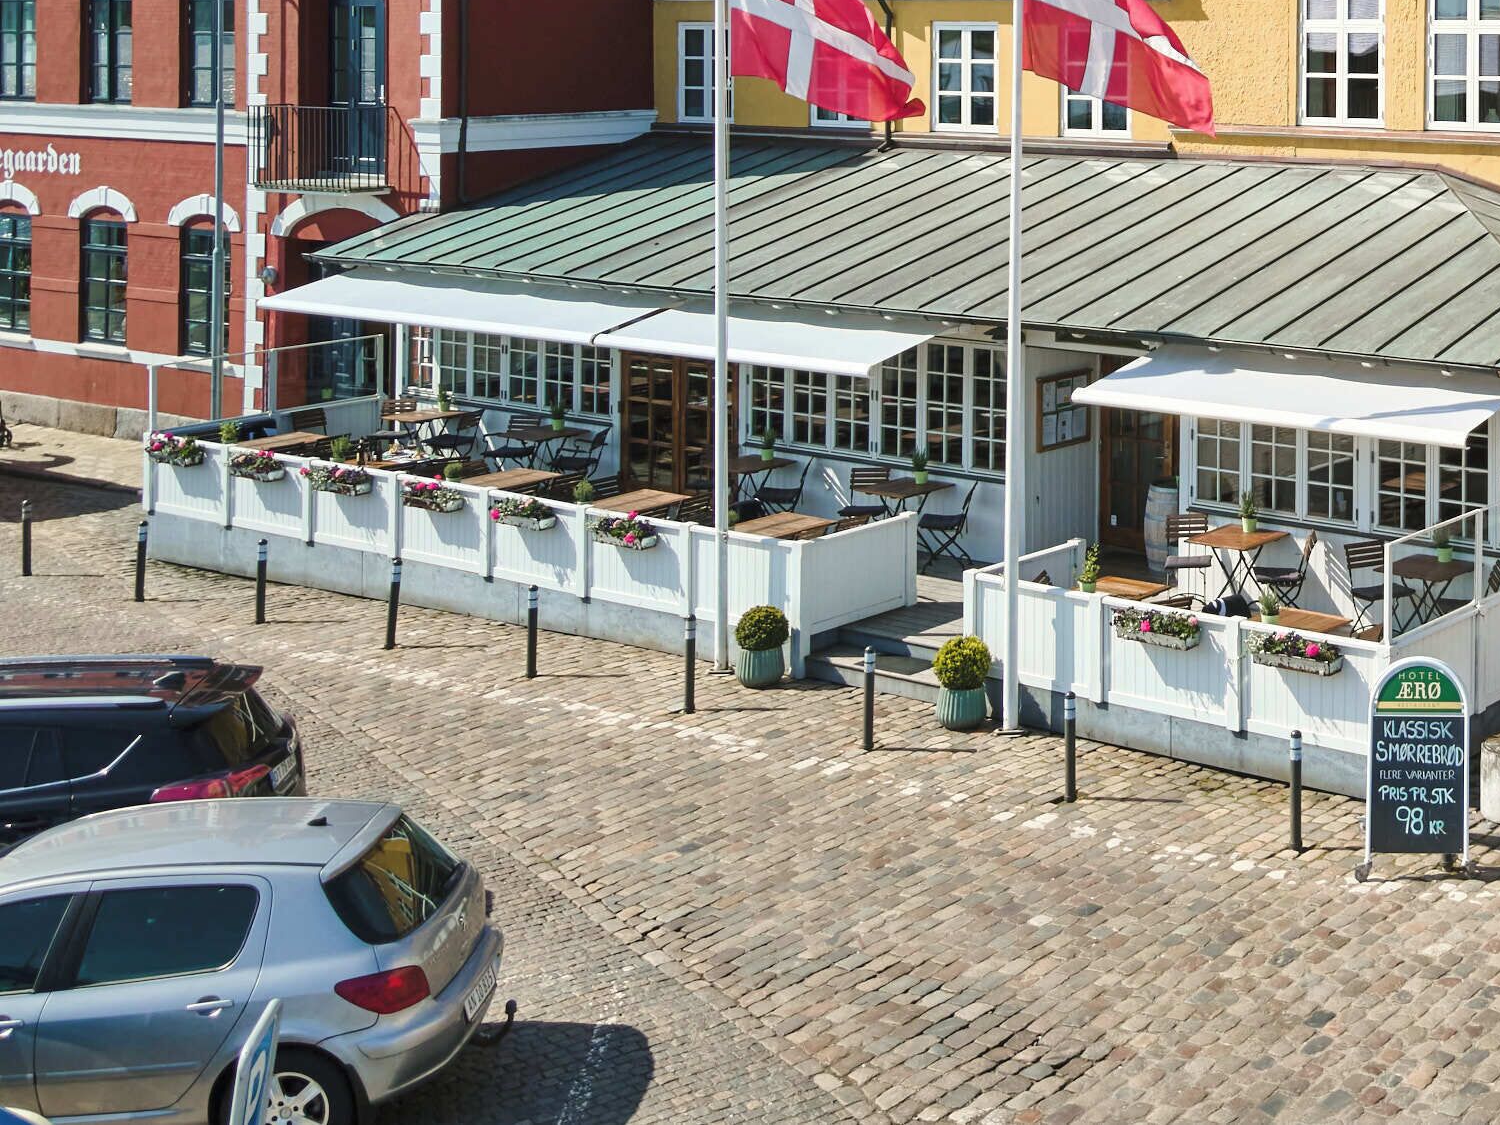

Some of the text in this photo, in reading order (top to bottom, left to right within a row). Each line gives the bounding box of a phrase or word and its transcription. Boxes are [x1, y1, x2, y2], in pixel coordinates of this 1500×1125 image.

[1398, 671, 1441, 680] HOTEL
[1395, 681, 1442, 700] ÆRØ
[1383, 719, 1454, 739] KLASSISK
[1375, 740, 1464, 766] SMØRREBRØD
[1379, 769, 1456, 781] FLERE VARIANTER
[1378, 784, 1408, 801] PRIS
[1395, 805, 1447, 835] 98 KR
